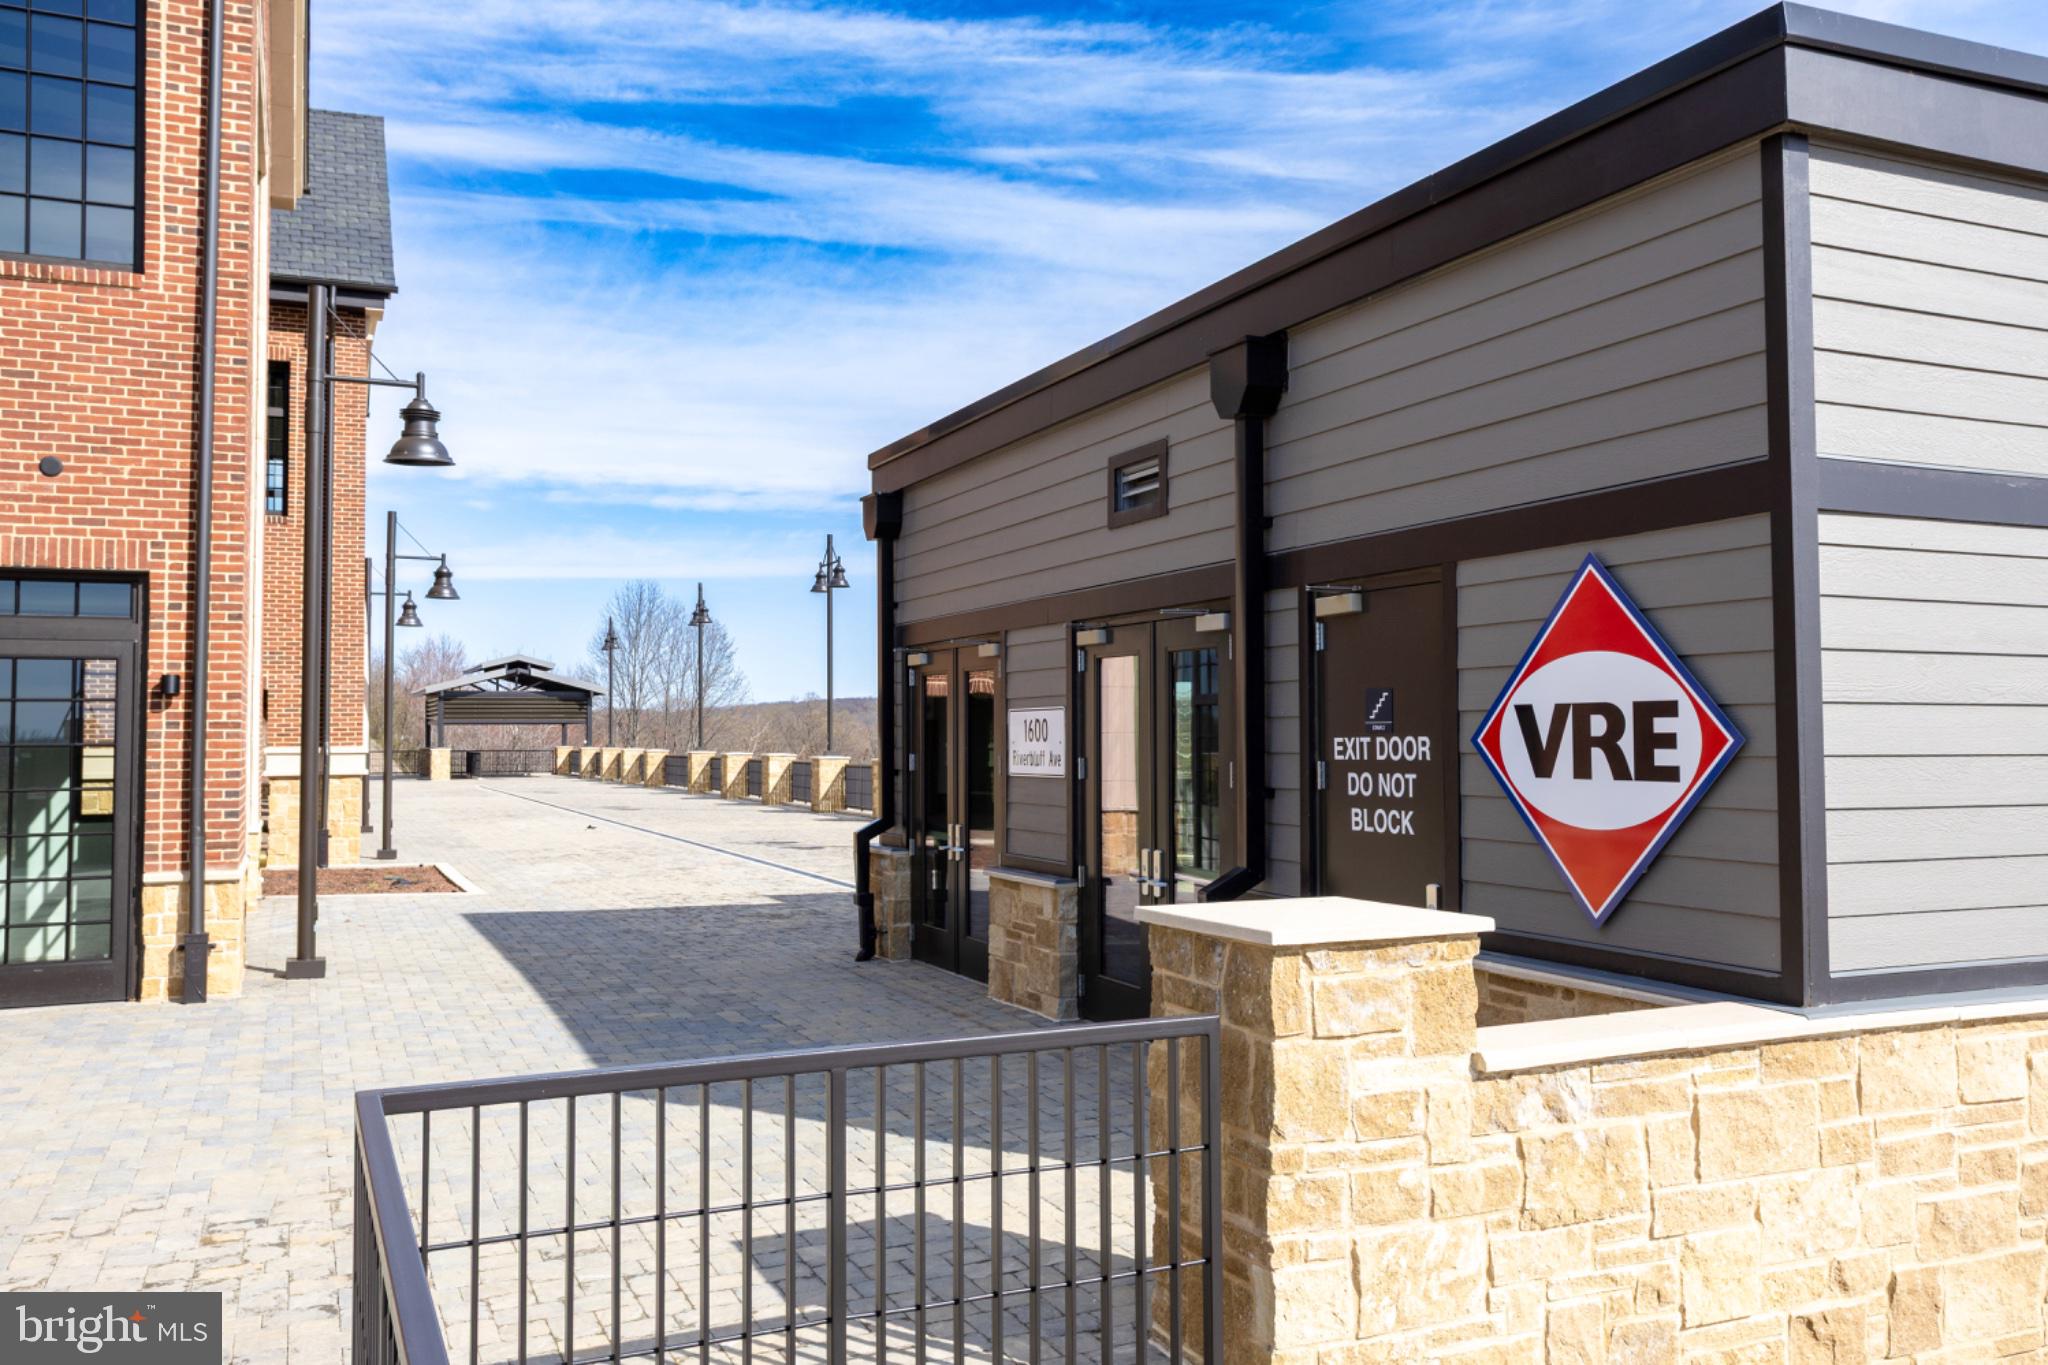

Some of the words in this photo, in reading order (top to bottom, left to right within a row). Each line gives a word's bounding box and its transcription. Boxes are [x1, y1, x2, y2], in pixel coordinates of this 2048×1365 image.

[1024, 718, 1048, 742] 1600
[1514, 700, 1680, 782] VRE
[1049, 751, 1061, 767] Ave
[1333, 737, 1371, 760] EXIT
[1376, 736, 1431, 761] DOOR
[1347, 772, 1372, 797] DO
[1378, 773, 1417, 798] NOT
[1351, 808, 1415, 835] BLOCK
